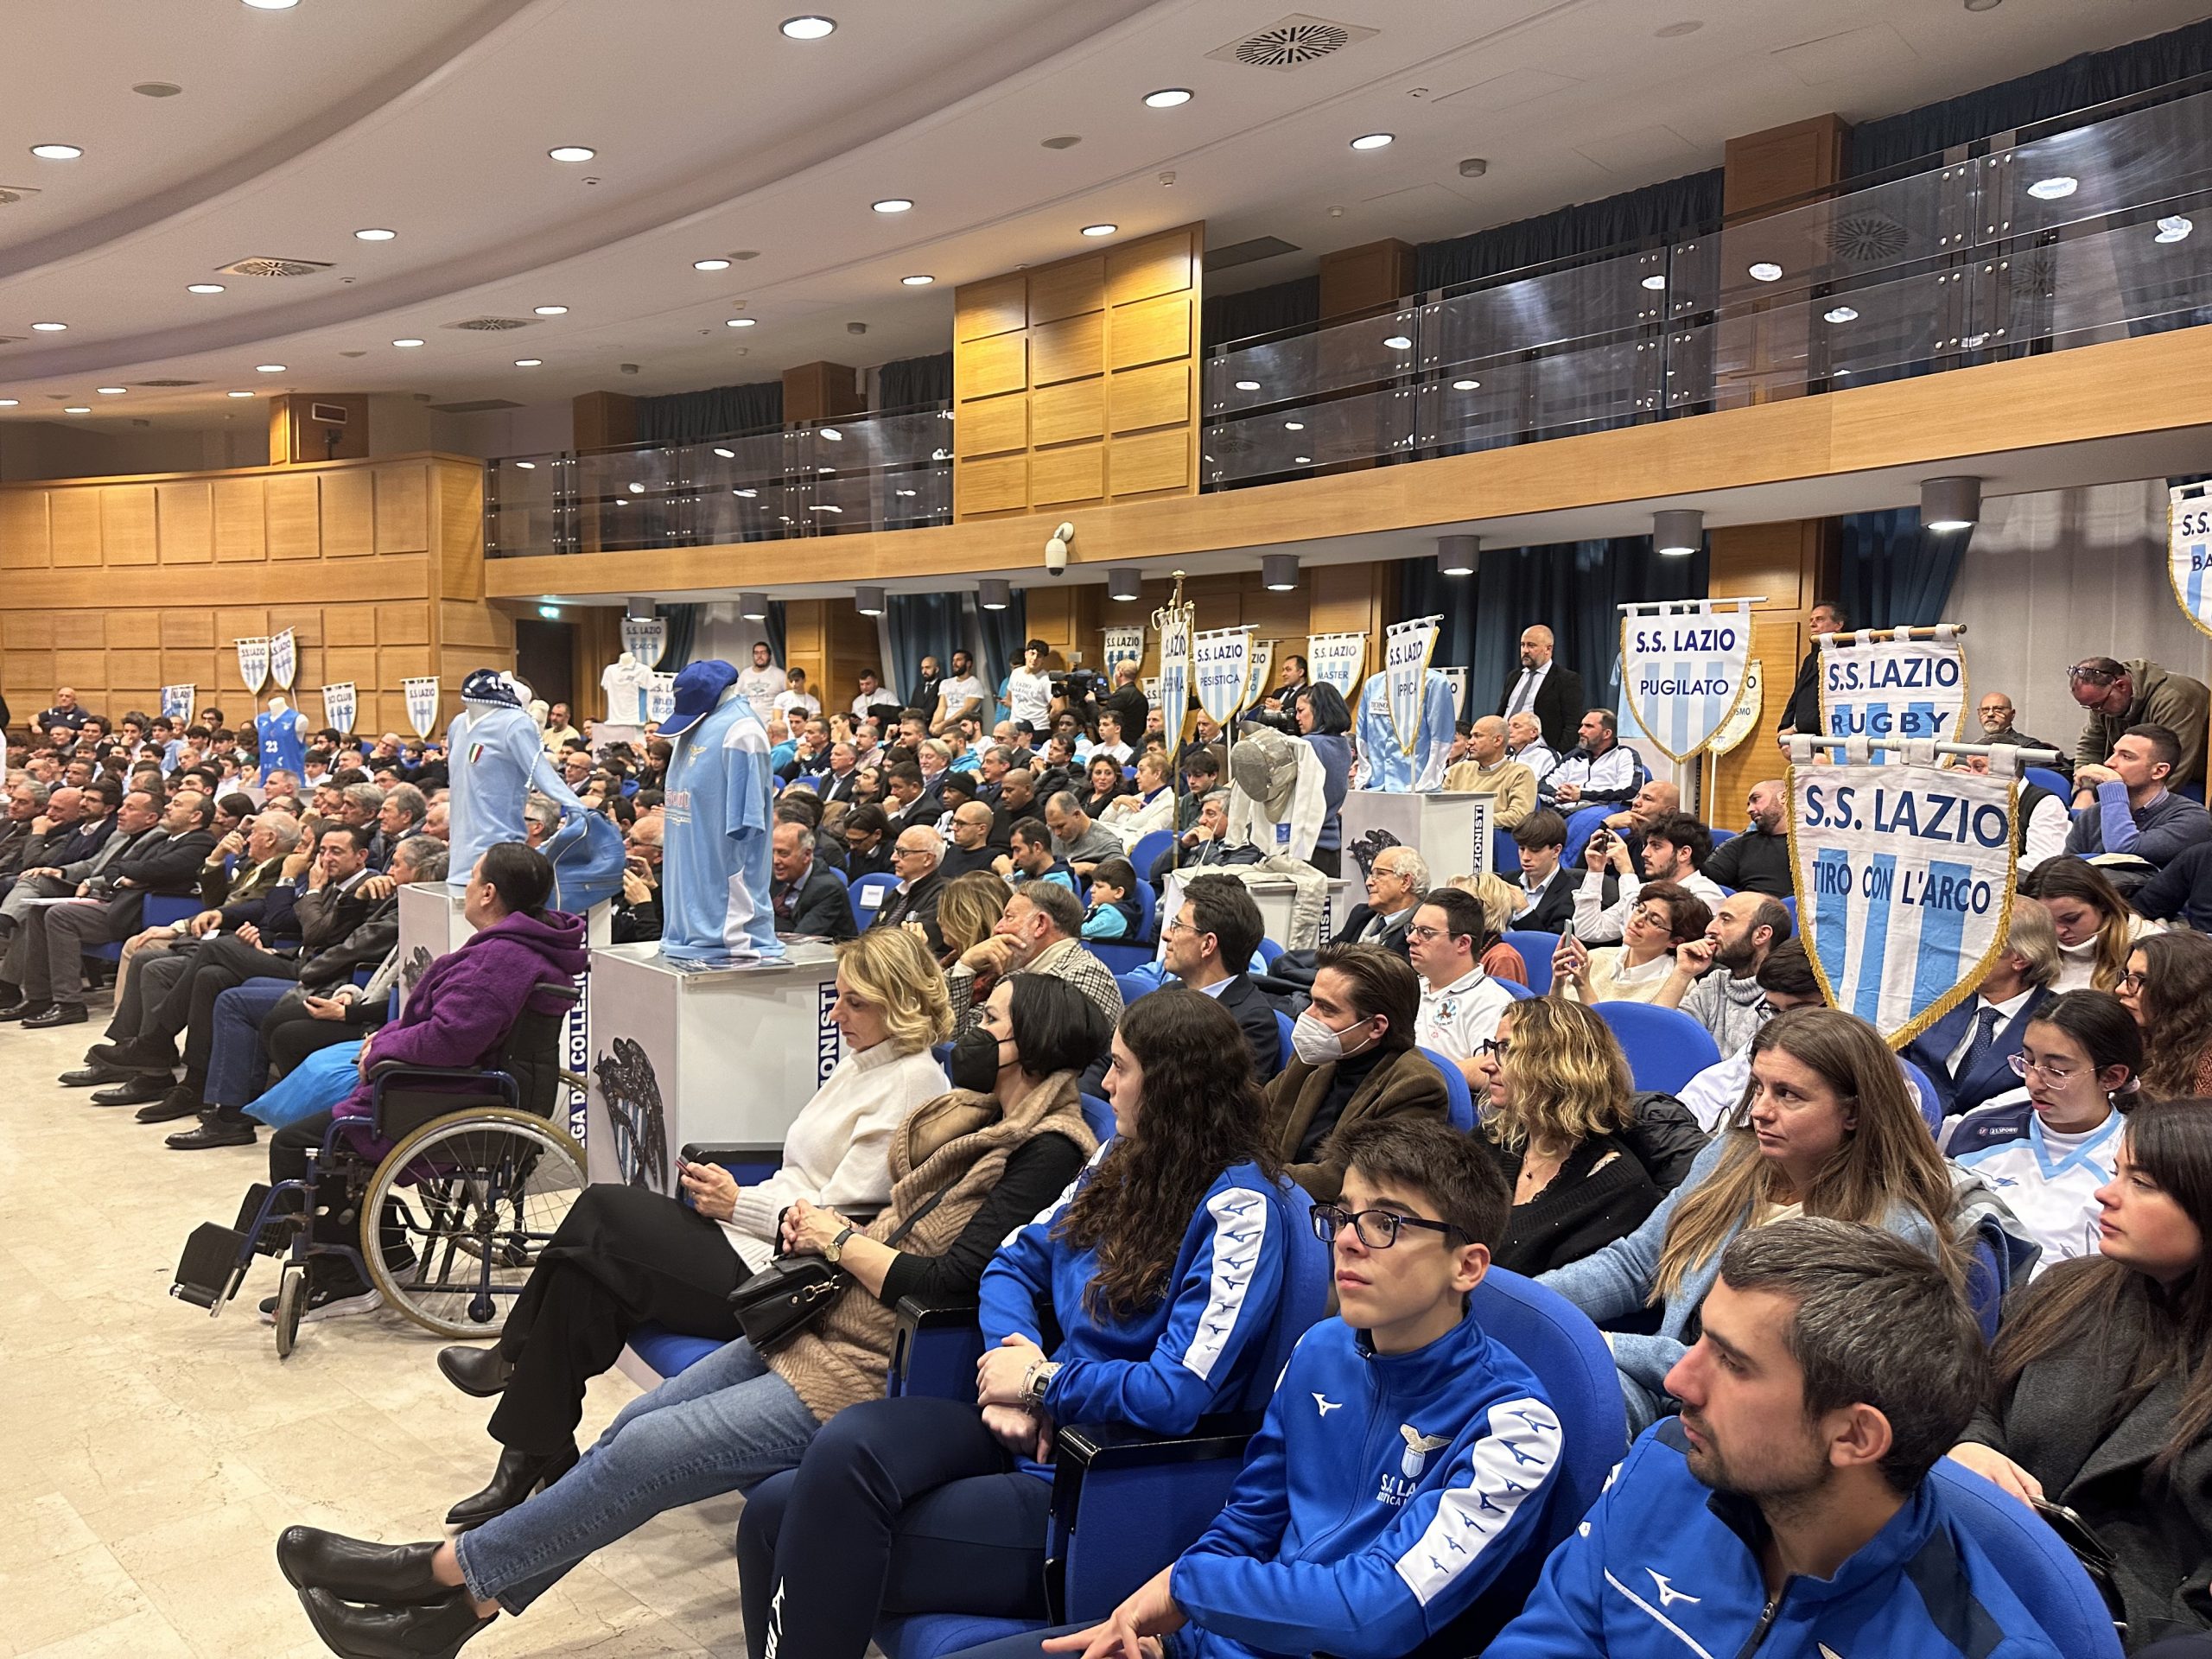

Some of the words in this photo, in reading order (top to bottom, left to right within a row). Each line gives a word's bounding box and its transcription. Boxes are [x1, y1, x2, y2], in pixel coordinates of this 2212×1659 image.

[2183, 512, 2209, 537] S.S.
[640, 626, 662, 634] LAZIO
[1116, 636, 1140, 646] LAZIO
[1636, 631, 1667, 653] S.S.
[1674, 628, 1736, 652] LAZIO
[1198, 648, 1211, 662] S.S.
[1214, 644, 1243, 659] LAZIO
[1251, 653, 1266, 664] ZIO
[1314, 647, 1327, 658] S.S.
[1329, 645, 1357, 657] LAZIO
[1389, 646, 1402, 666] S.S.
[1404, 640, 1423, 663] LAZIO
[1200, 673, 1241, 687] PESISTICA
[1318, 671, 1349, 680] MASTER
[1828, 662, 1864, 691] S.S.
[1869, 658, 1959, 689] LAZIO
[418, 688, 435, 697] LAZIO
[1397, 681, 1417, 697] IPPICA
[1640, 679, 1729, 696] PUGILATO
[337, 693, 353, 702] CLUB
[1831, 712, 1949, 734] RUGBY
[265, 740, 278, 753] 23
[1806, 785, 1862, 830] S.S.
[1874, 788, 2009, 849] LAZIO
[1813, 861, 1853, 896] TIRO
[1863, 865, 1894, 901] CON
[1902, 871, 1991, 915] L'ARCO
